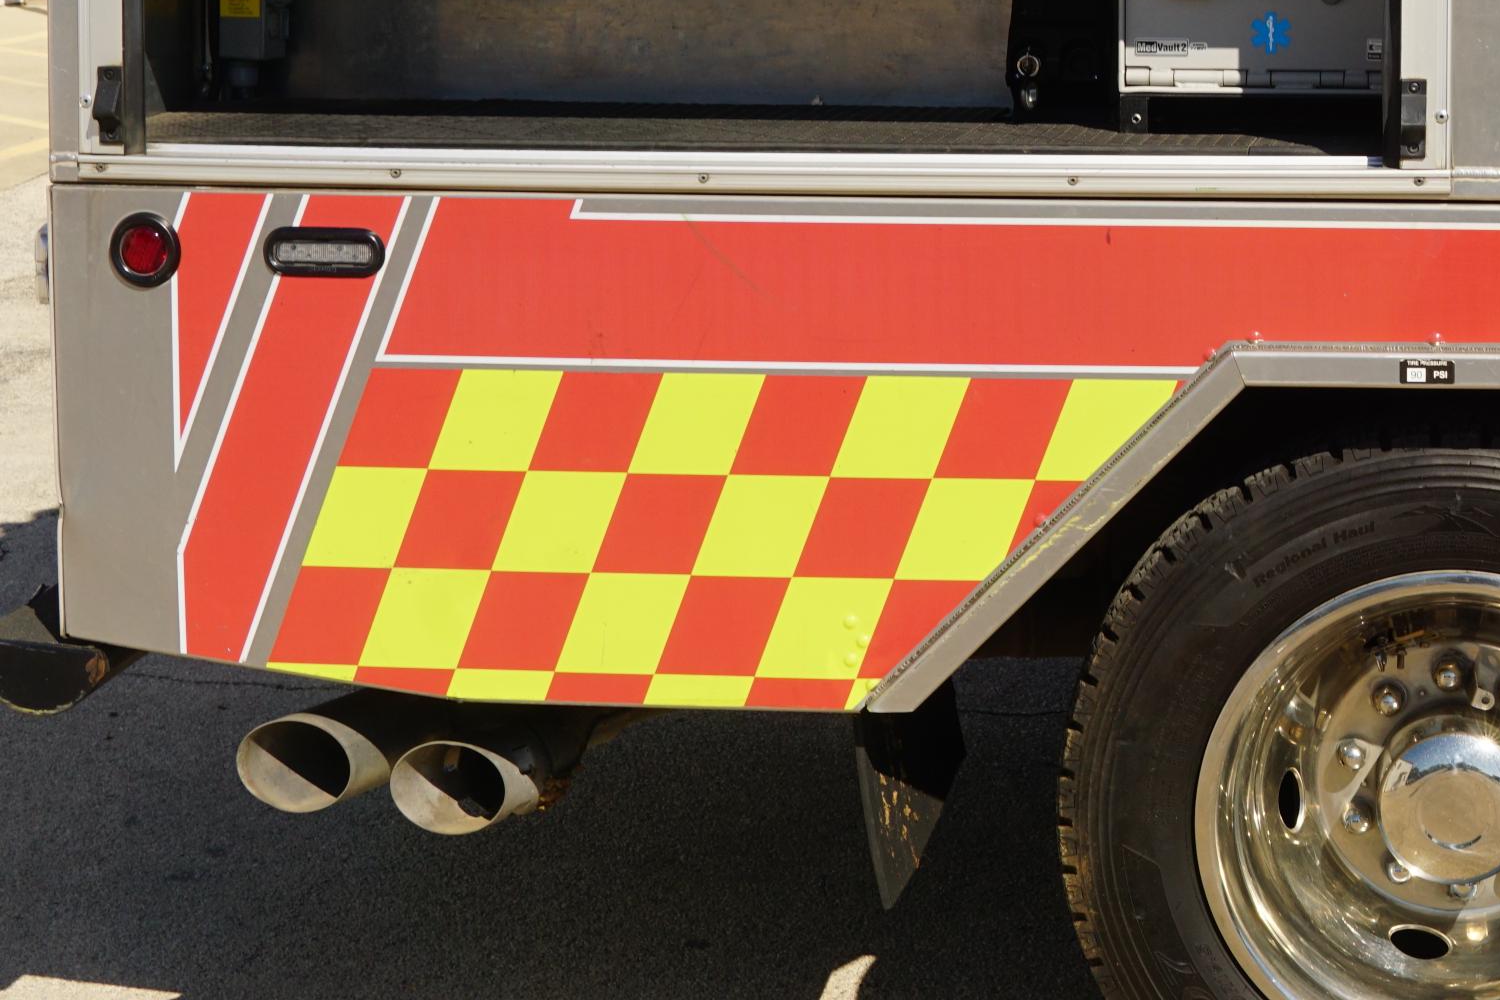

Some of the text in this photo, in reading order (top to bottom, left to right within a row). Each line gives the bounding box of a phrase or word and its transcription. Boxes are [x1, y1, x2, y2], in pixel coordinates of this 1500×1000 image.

[1410, 370, 1448, 379] 90 PSI
[1252, 537, 1328, 588] Regional
[1333, 520, 1376, 544] Haul
